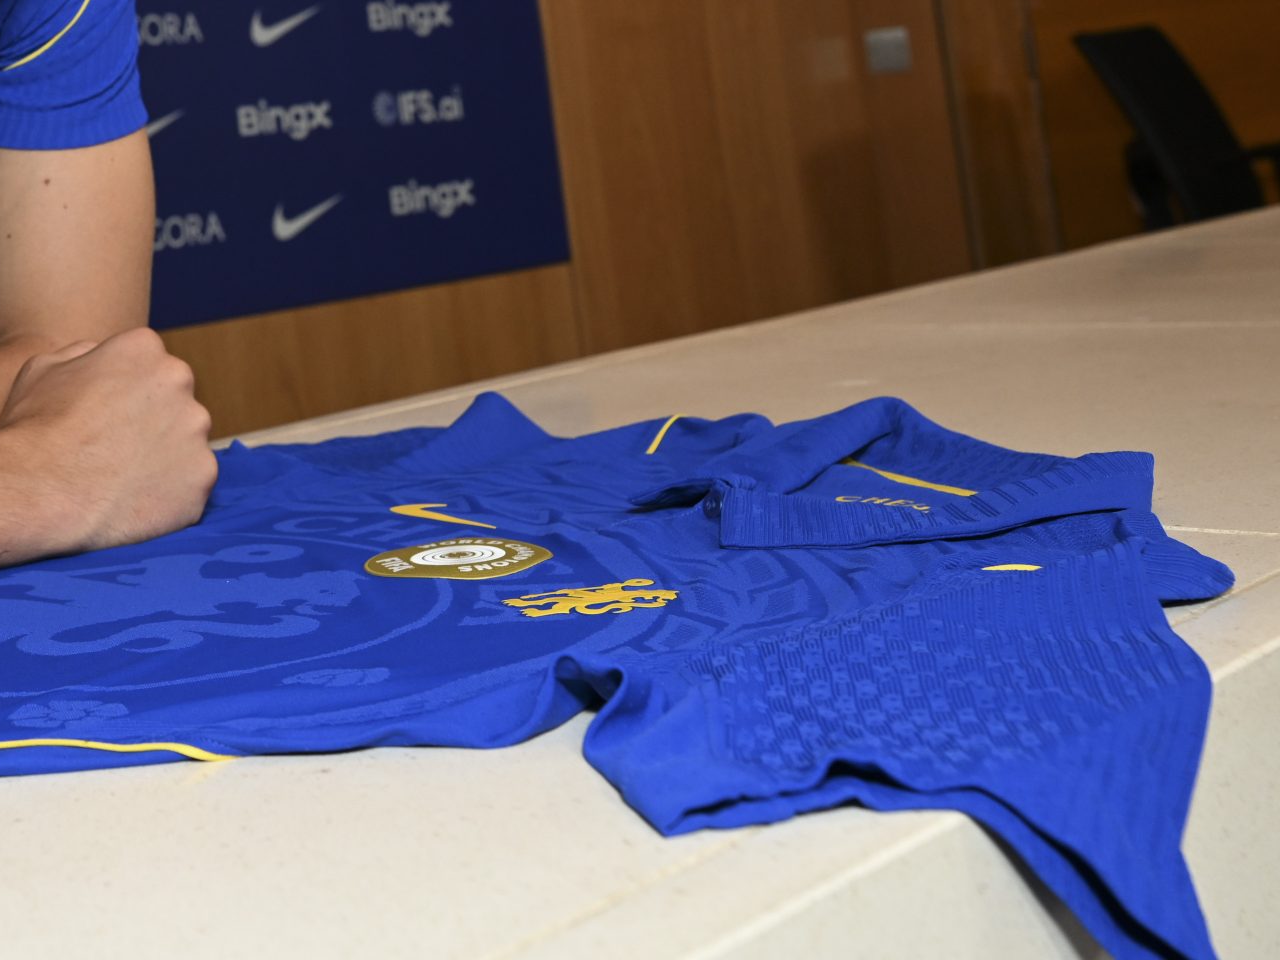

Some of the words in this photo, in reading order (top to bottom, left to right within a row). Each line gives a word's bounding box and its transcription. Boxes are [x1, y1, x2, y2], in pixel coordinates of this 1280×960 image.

[137, 12, 204, 47] ORA
[396, 87, 464, 124] IFS.ai
[375, 556, 415, 573] FIFA
